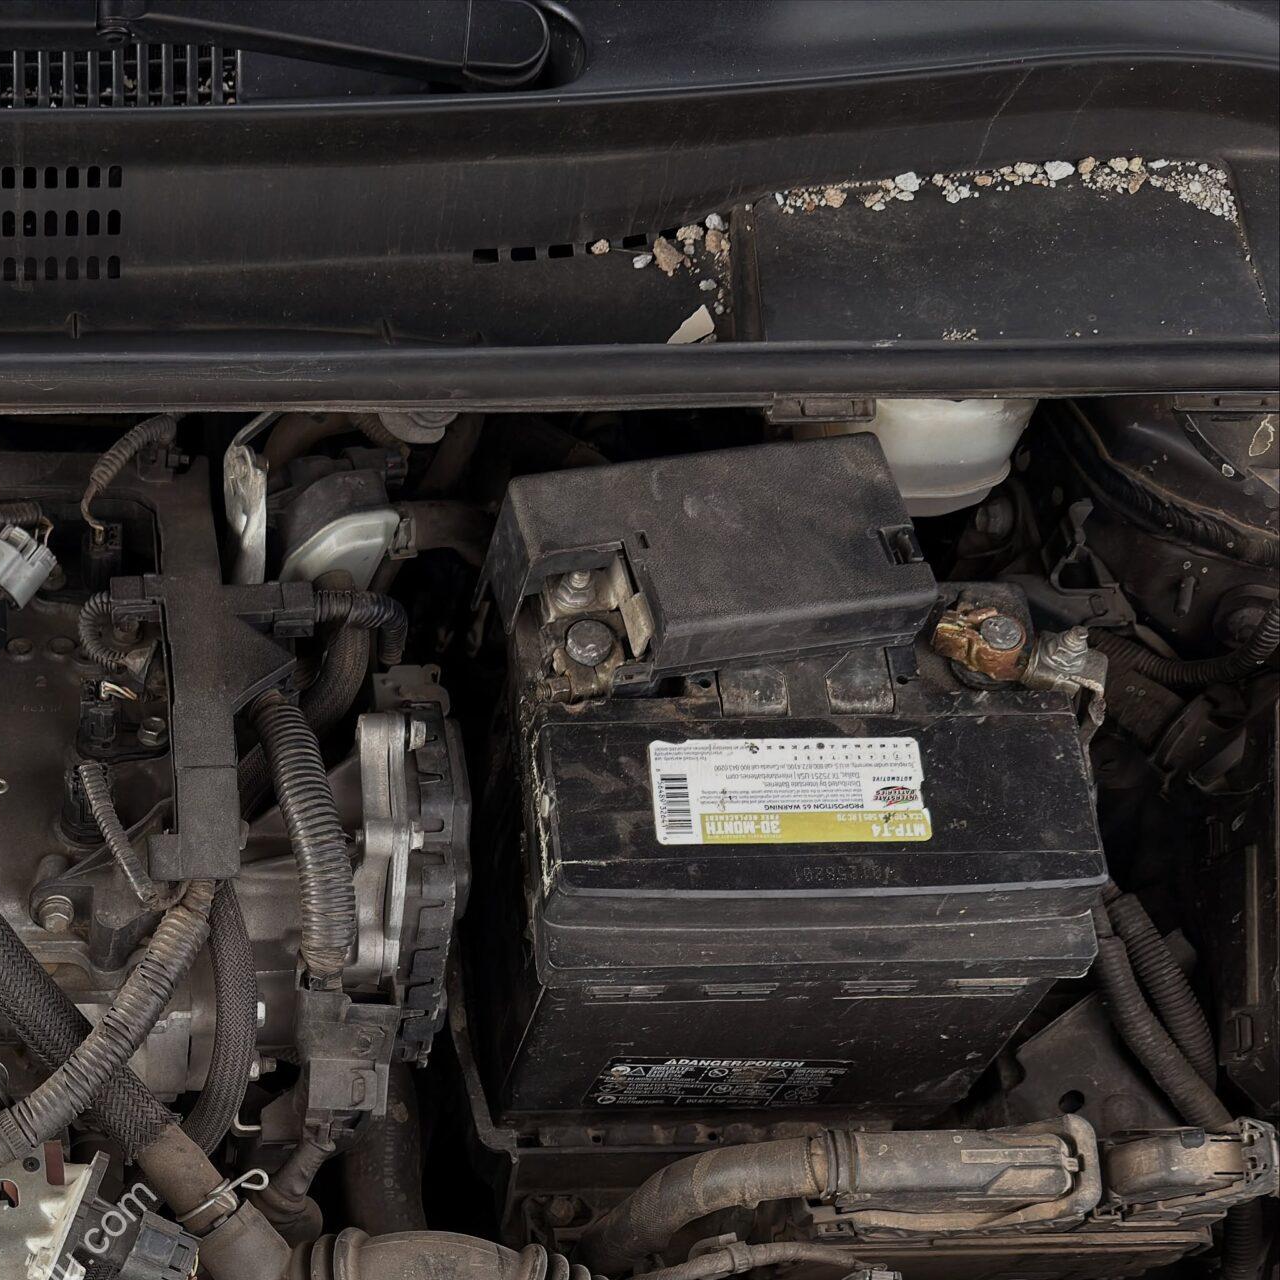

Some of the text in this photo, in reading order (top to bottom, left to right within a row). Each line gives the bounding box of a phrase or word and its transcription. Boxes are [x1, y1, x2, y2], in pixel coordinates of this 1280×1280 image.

[872, 794, 919, 802] INTERSTATE
[813, 802, 864, 810] PROPOSITION
[705, 821, 780, 834] 30-MONTH
[871, 823, 926, 837] MTP-T4
[677, 1059, 805, 1068] DANGER/POISON
